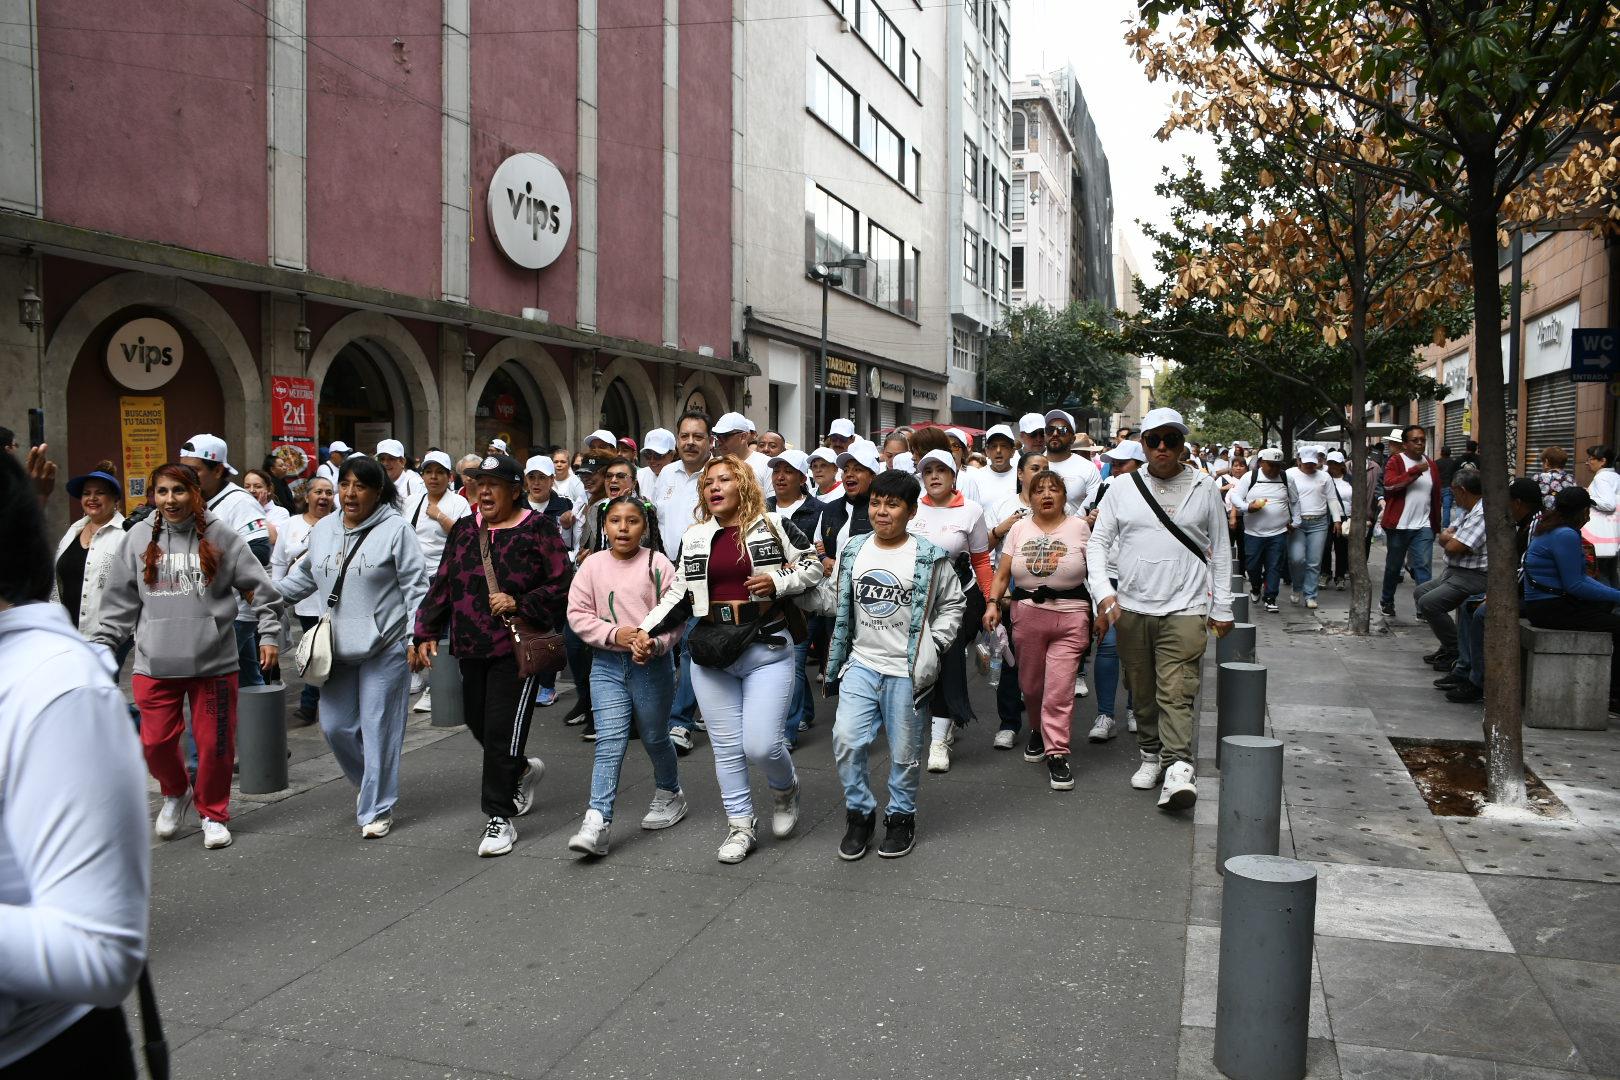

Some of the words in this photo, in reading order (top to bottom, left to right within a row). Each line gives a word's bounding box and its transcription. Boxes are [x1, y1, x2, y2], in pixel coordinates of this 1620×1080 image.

[506, 181, 560, 240] vips
[1582, 335, 1614, 351] WC
[120, 336, 173, 373] vips
[830, 373, 851, 388] COFFEE
[1572, 373, 1609, 381] ENTRADA
[124, 409, 162, 417] BUSCAMOS
[283, 401, 305, 425] 2x1
